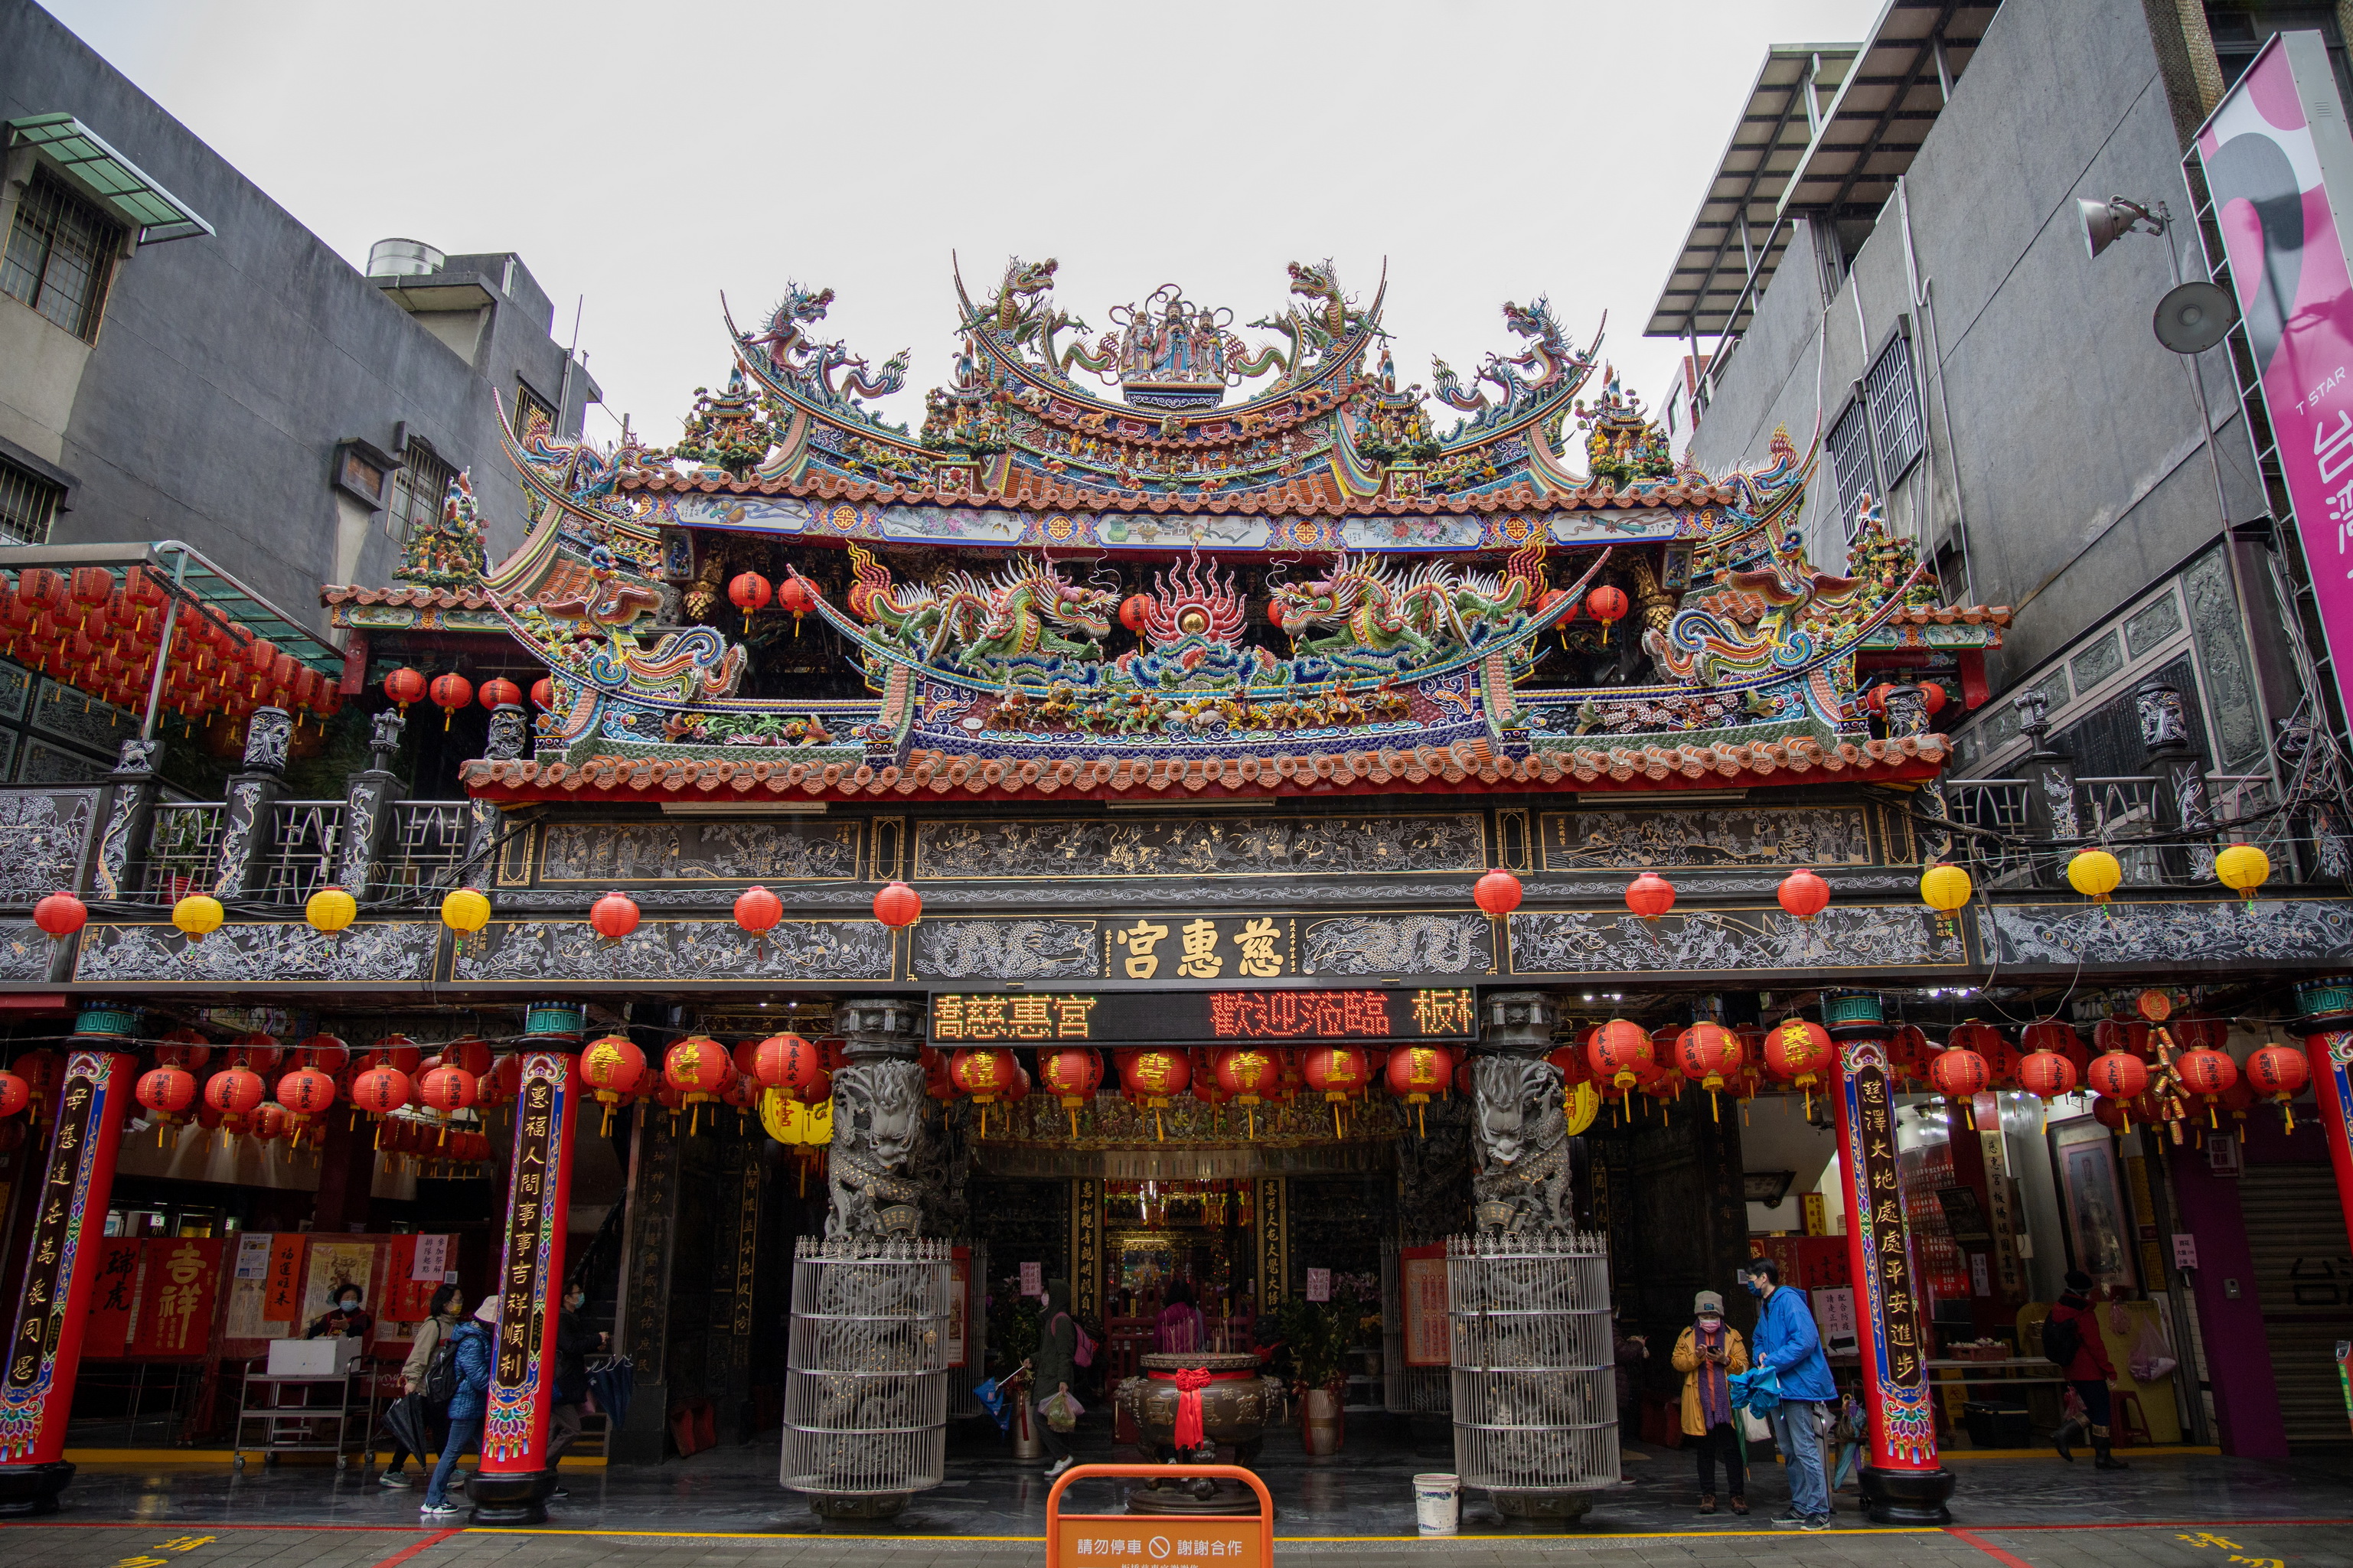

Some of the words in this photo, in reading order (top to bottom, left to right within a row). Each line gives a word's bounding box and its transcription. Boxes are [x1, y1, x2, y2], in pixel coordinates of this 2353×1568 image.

[2309, 367, 2345, 406] STAR
[747, 575, 757, 601] 風調雨順
[1132, 598, 1141, 622] 風調雨順
[1118, 918, 1284, 979] 慈惠宮
[786, 1039, 800, 1081] 國泰民安
[1597, 1026, 1616, 1067] 國泰民安
[1683, 1028, 1703, 1071] 風調雨順
[2051, 1058, 2064, 1091] 天上聖母
[2107, 1060, 2121, 1094] 天上聖母
[2259, 1052, 2279, 1085] 風調雨順
[155, 1080, 165, 1107] 慈惠宮
[221, 1077, 234, 1109] 天上聖母
[300, 1077, 312, 1109] 國泰民安
[378, 1081, 390, 1107] 慈惠宮
[449, 1075, 461, 1107] 風調雨順
[155, 1216, 162, 1224] 5
[499, 1086, 550, 1380] 惠福人間事事吉祥順利
[1862, 1080, 1915, 1379] 慈澤大地處處平安進步
[421, 1237, 434, 1273] 排隊起點
[432, 1237, 445, 1273] 參加祭解
[1079, 1181, 1095, 1316] 惠如觀音觀明觀自
[103, 1247, 135, 1311] 瑞虎
[273, 1247, 294, 1307] 福運旺來
[158, 1241, 207, 1350] 吉祥
[1826, 1294, 1838, 1332] 請走正門
[1838, 1294, 1850, 1331] 配合防疫
[1077, 1539, 1142, 1556] 請勿停車
[1176, 1540, 1242, 1557] 謝謝合作
